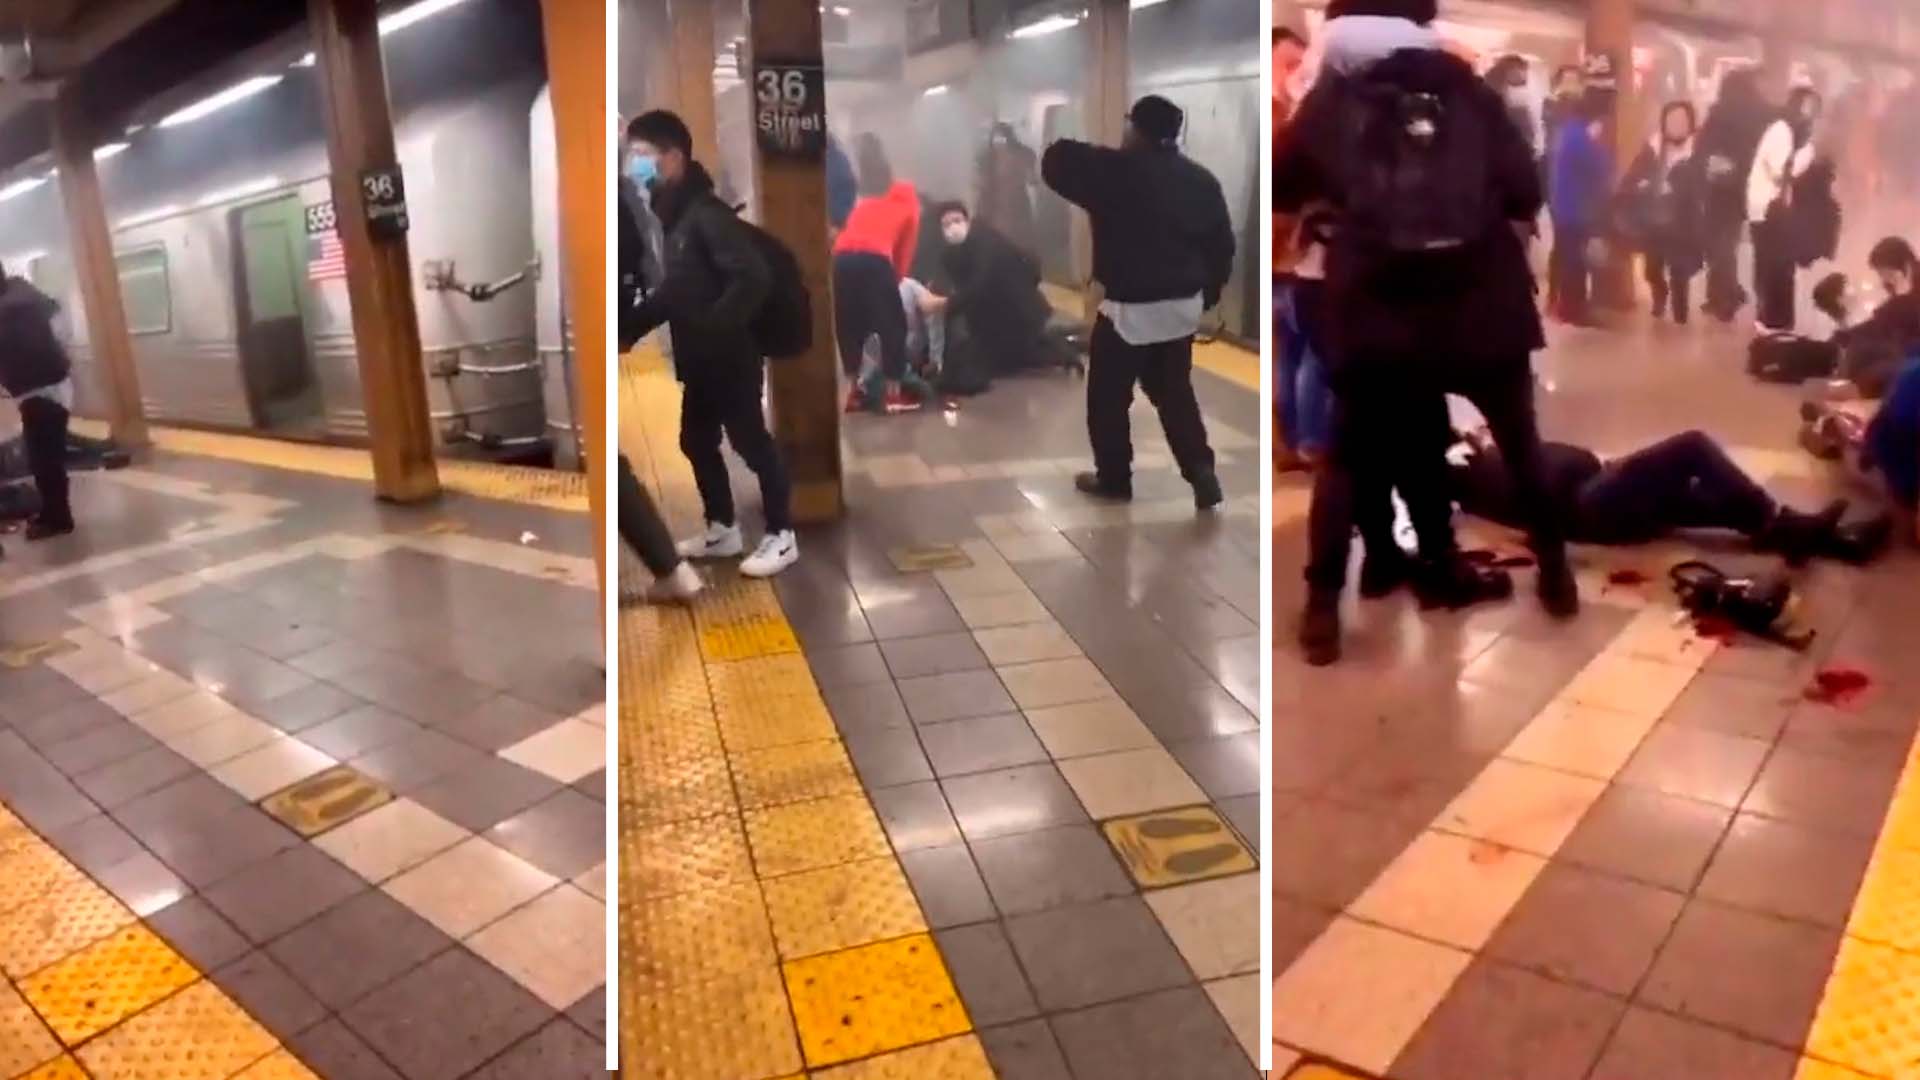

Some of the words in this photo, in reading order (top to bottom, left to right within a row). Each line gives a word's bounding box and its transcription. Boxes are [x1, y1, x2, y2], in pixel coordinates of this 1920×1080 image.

[757, 70, 806, 106] 36
[759, 111, 821, 132] Street
[363, 175, 394, 200] 36
